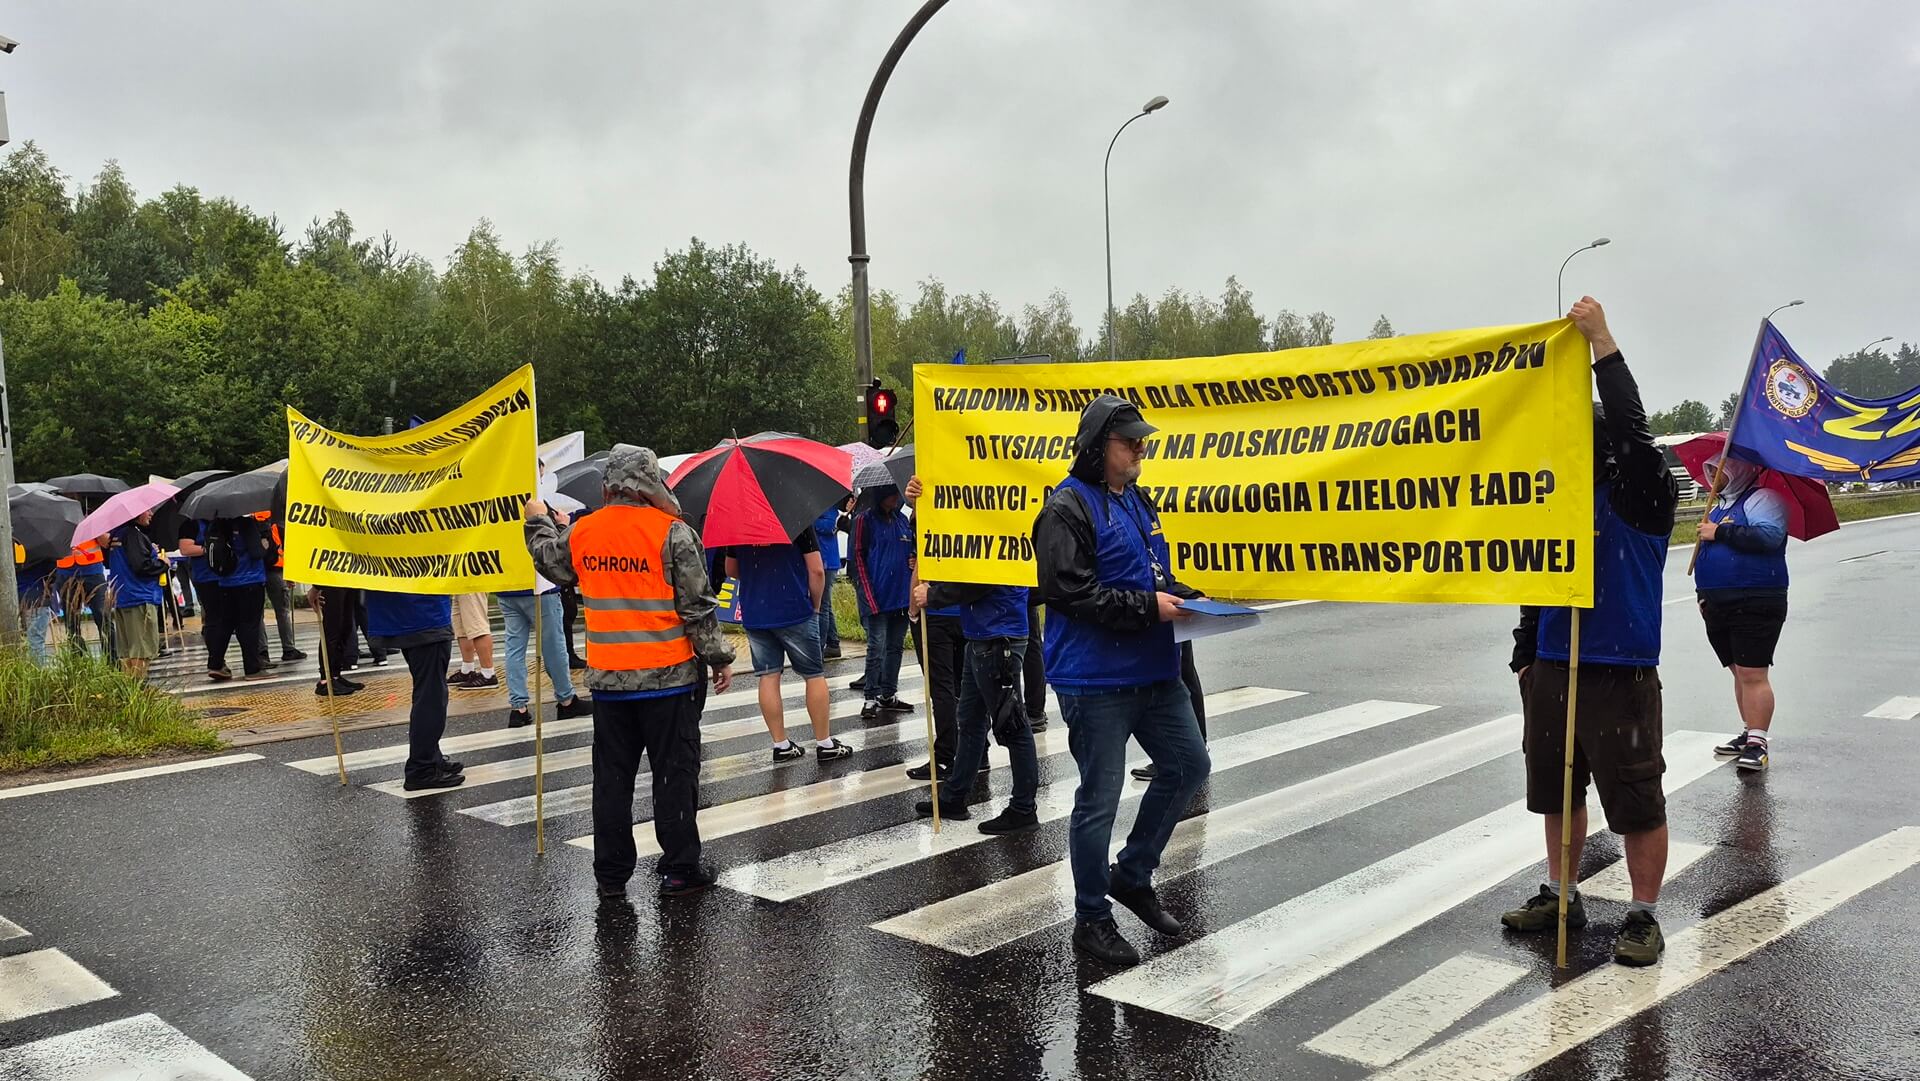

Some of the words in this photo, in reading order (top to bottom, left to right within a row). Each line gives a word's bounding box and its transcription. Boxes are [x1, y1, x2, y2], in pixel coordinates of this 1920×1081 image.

[933, 387, 1030, 415] RZĄDOWA
[1034, 385, 1147, 413] STRATIA
[1145, 383, 1193, 409] DLA
[1193, 368, 1377, 406] TRANSPORTU
[1377, 340, 1547, 391] TOWARÓW
[965, 434, 987, 460] TO
[988, 434, 1073, 464] TYSIĄCE
[1163, 433, 1196, 460] NA
[1200, 422, 1329, 459] POLSKICH
[1332, 407, 1481, 450] DROGACH
[322, 467, 387, 493] POLSKICH
[933, 485, 1027, 512] HIPOKRYCI
[1184, 481, 1312, 514] EKOLOGIA
[1319, 481, 1329, 512] I
[1335, 475, 1461, 511] ZIELONY
[1469, 469, 1555, 506] ŁAD?
[288, 502, 328, 527] CZAS
[365, 509, 434, 535] TRANSPORT
[309, 548, 318, 569] I
[383, 554, 452, 578] MASOWYCH
[462, 550, 504, 577] TORY
[582, 555, 650, 573] OCHRONA
[923, 528, 994, 563] ŻĄDAMY
[1177, 541, 1295, 573] POLITYKI
[1300, 538, 1576, 573] TRANSPORTOWEJ
